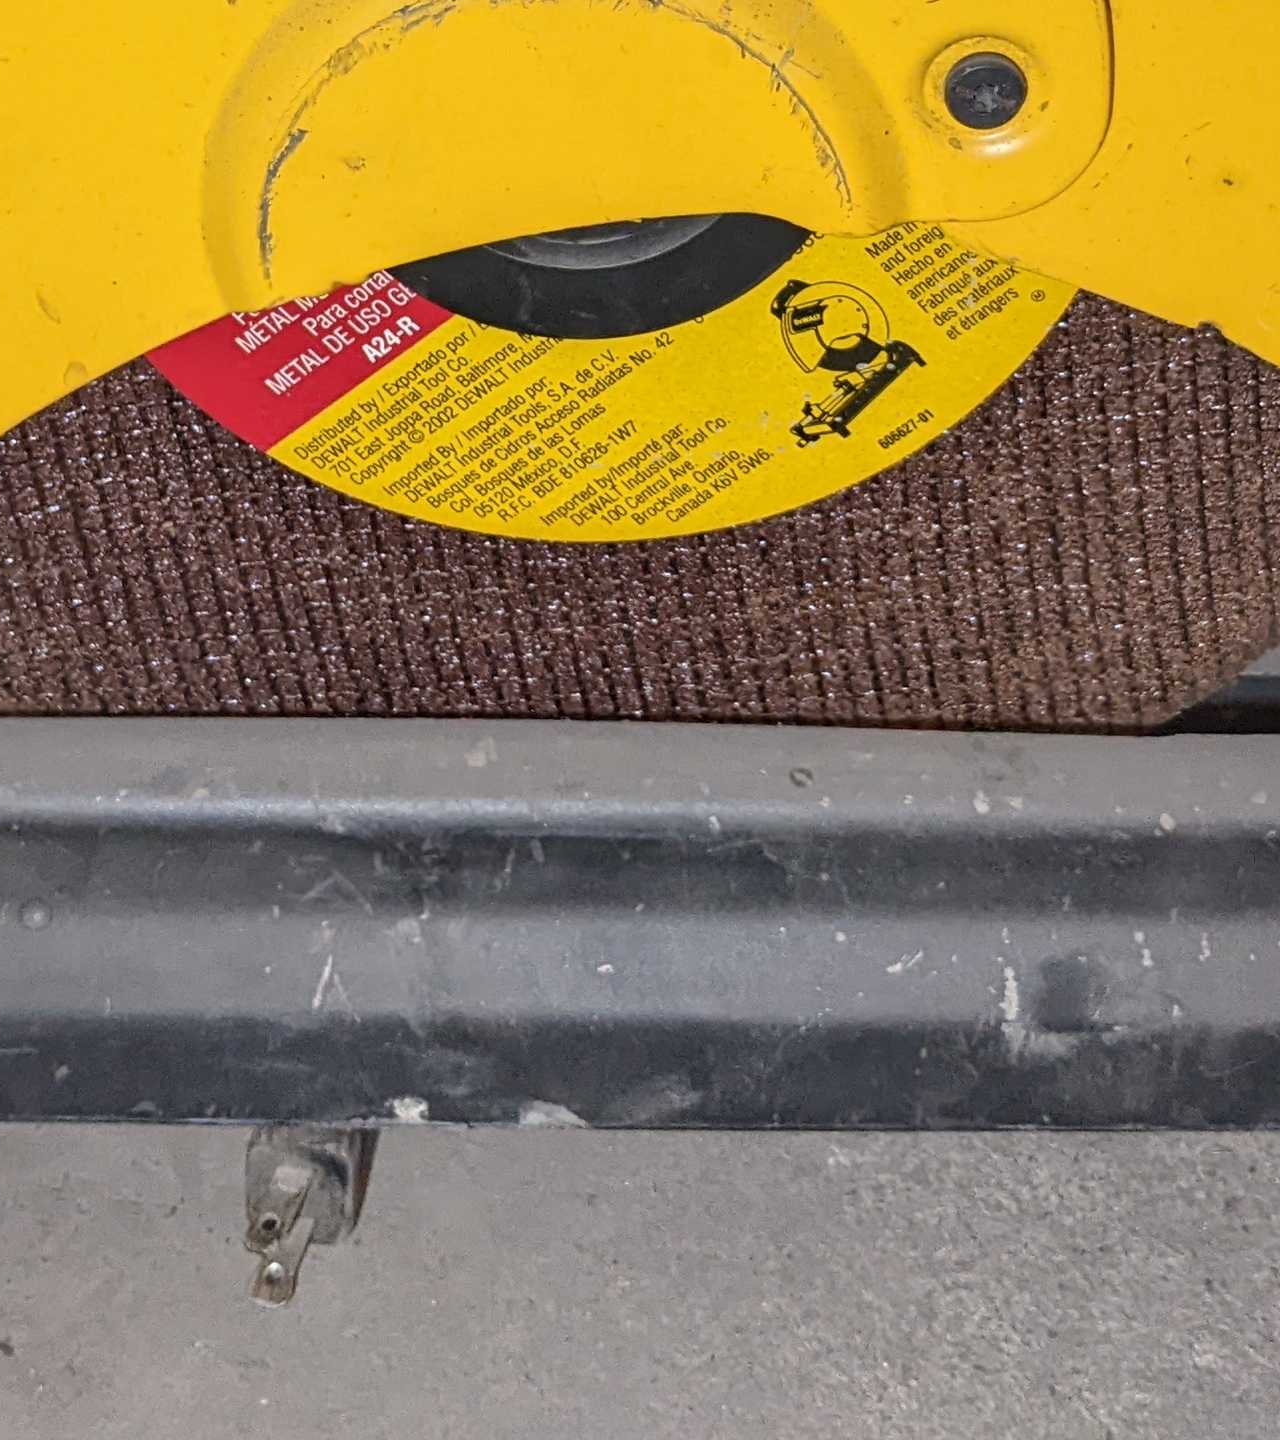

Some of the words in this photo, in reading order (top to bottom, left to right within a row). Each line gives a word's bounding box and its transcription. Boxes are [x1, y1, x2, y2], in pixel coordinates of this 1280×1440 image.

[864, 229, 903, 259] Made
[903, 222, 919, 235] in
[880, 249, 906, 272] and
[903, 224, 945, 255] foreig
[891, 254, 934, 286] Hecho
[934, 241, 952, 258] en
[917, 271, 972, 314] Fabriqué
[972, 256, 999, 278] aux
[932, 304, 958, 327] des
[956, 265, 1020, 310] matériaux
[946, 324, 962, 340] et
[960, 287, 1020, 330] étrangers
[235, 306, 300, 354] MÉTAL
[265, 349, 329, 395] METAL
[322, 326, 355, 353] DE
[347, 300, 391, 334] USO
[302, 304, 348, 336] Para
[362, 316, 420, 363] A24-R
[294, 408, 362, 460] Distributed
[358, 398, 379, 414] by
[382, 349, 449, 396] Exportado
[446, 331, 469, 355] por
[350, 440, 412, 485] Copyright
[422, 406, 459, 434] 2002
[506, 336, 563, 373] Industr
[363, 387, 423, 432] Industrial
[418, 367, 450, 391] Tool
[426, 470, 481, 509] Bosques
[480, 458, 497, 473] de
[494, 430, 537, 461] Cidros
[534, 400, 580, 434] Acceso
[577, 363, 633, 402] Radiatas
[655, 332, 674, 348] 42
[454, 422, 514, 467] Industrial
[575, 368, 593, 384] de
[590, 349, 619, 372] C.V.
[329, 456, 357, 478] 701
[354, 436, 386, 460] East
[384, 411, 424, 441] Joppa
[382, 453, 445, 496] Imported
[436, 443, 458, 463] By
[461, 395, 526, 441] Importado
[473, 458, 529, 498] Bosques
[527, 446, 545, 461] de
[541, 433, 564, 449] las
[560, 403, 606, 436] Lomas
[878, 409, 934, 449] 606627-01
[531, 474, 563, 498] BDE
[559, 420, 637, 479] 810626-1W7
[621, 445, 681, 491] Industrial
[676, 428, 708, 451] Tool
[473, 486, 515, 518] 05120
[539, 483, 598, 526] Imported
[601, 504, 628, 525] 100
[625, 475, 671, 509] Central
[665, 489, 714, 522] Canada
[710, 468, 738, 492] K6V
